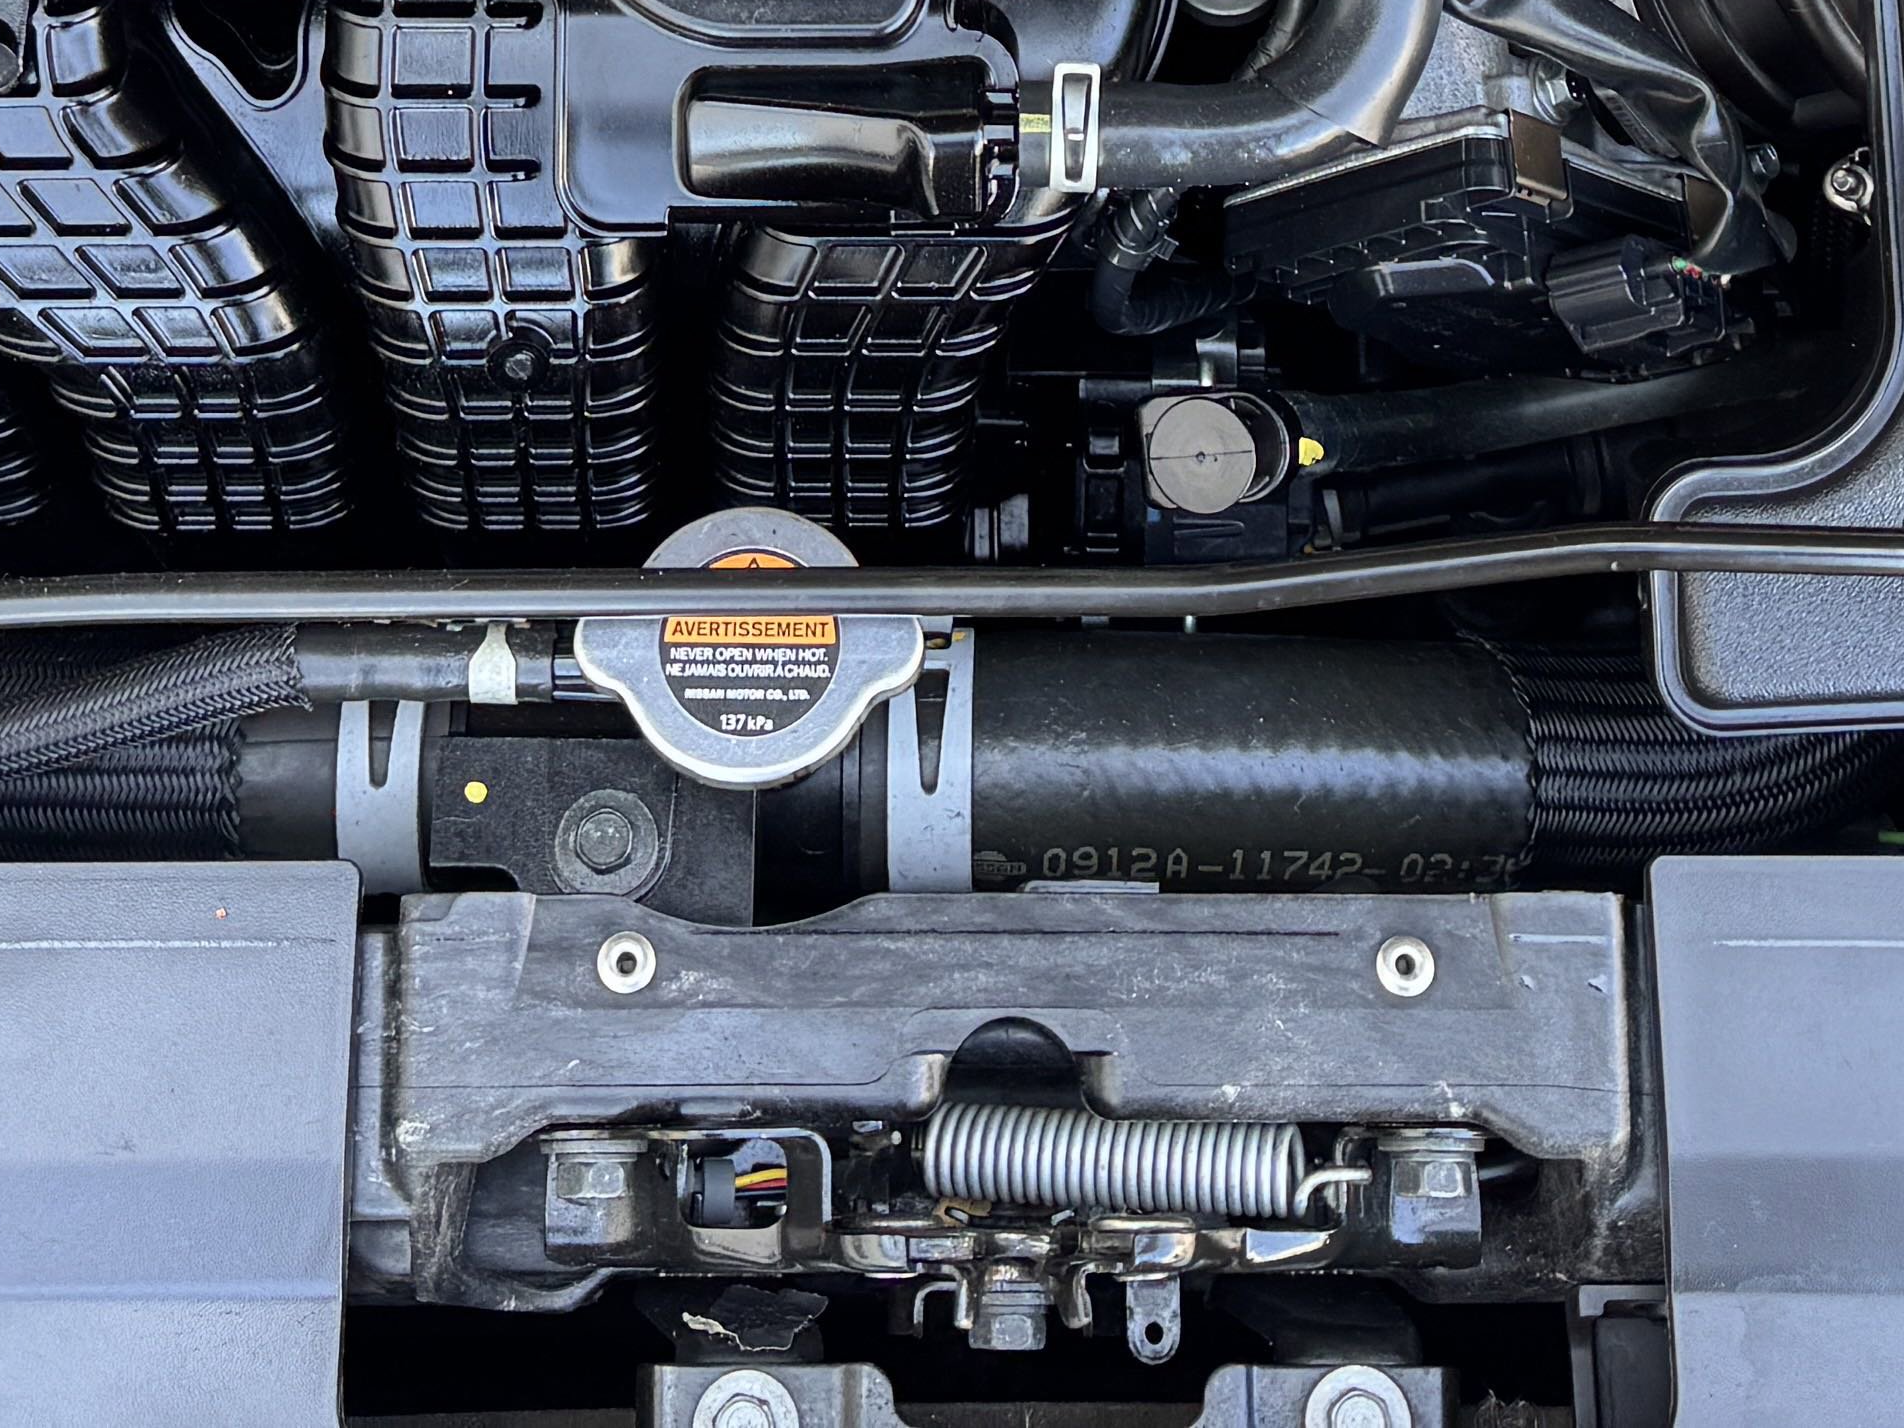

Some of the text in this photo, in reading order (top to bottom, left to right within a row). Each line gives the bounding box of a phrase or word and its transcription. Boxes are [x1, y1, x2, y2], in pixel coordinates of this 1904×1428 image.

[671, 621, 829, 638] AVERTISSEMENT
[670, 647, 828, 662] NEVER OPEN WHEN HOT.
[666, 664, 683, 677] NE
[683, 664, 727, 678] JAMAIS
[728, 664, 774, 678] OUVRIR
[785, 664, 831, 678] CHAUD.
[684, 688, 725, 700] NISSAN
[727, 689, 765, 700] MOTOR
[720, 714, 773, 731] 137 kPa
